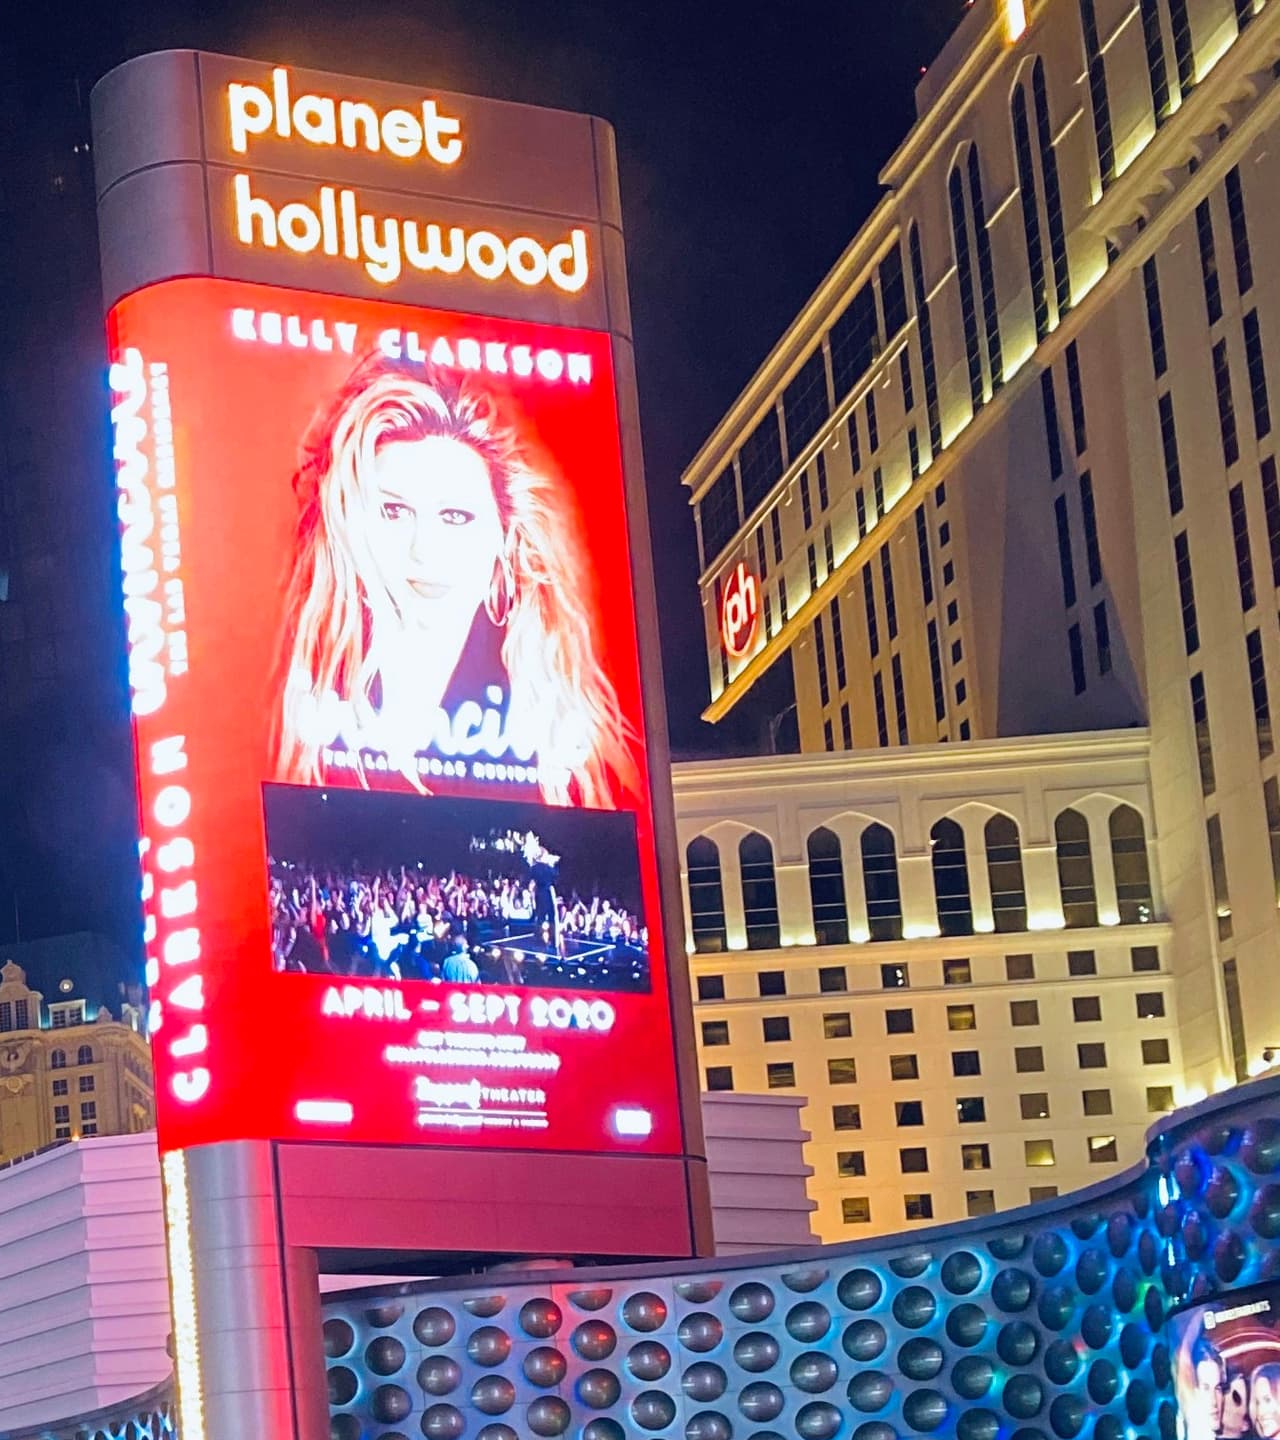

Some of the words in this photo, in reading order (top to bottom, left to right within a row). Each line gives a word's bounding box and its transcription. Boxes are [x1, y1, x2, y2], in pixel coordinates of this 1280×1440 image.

[228, 68, 463, 165] planet
[234, 173, 589, 293] hollywood
[230, 307, 358, 355] KELLY
[377, 328, 593, 385] CLARKSON
[321, 985, 412, 1022] APRIL
[448, 991, 521, 1026] SEPT
[530, 996, 615, 1031] 2020
